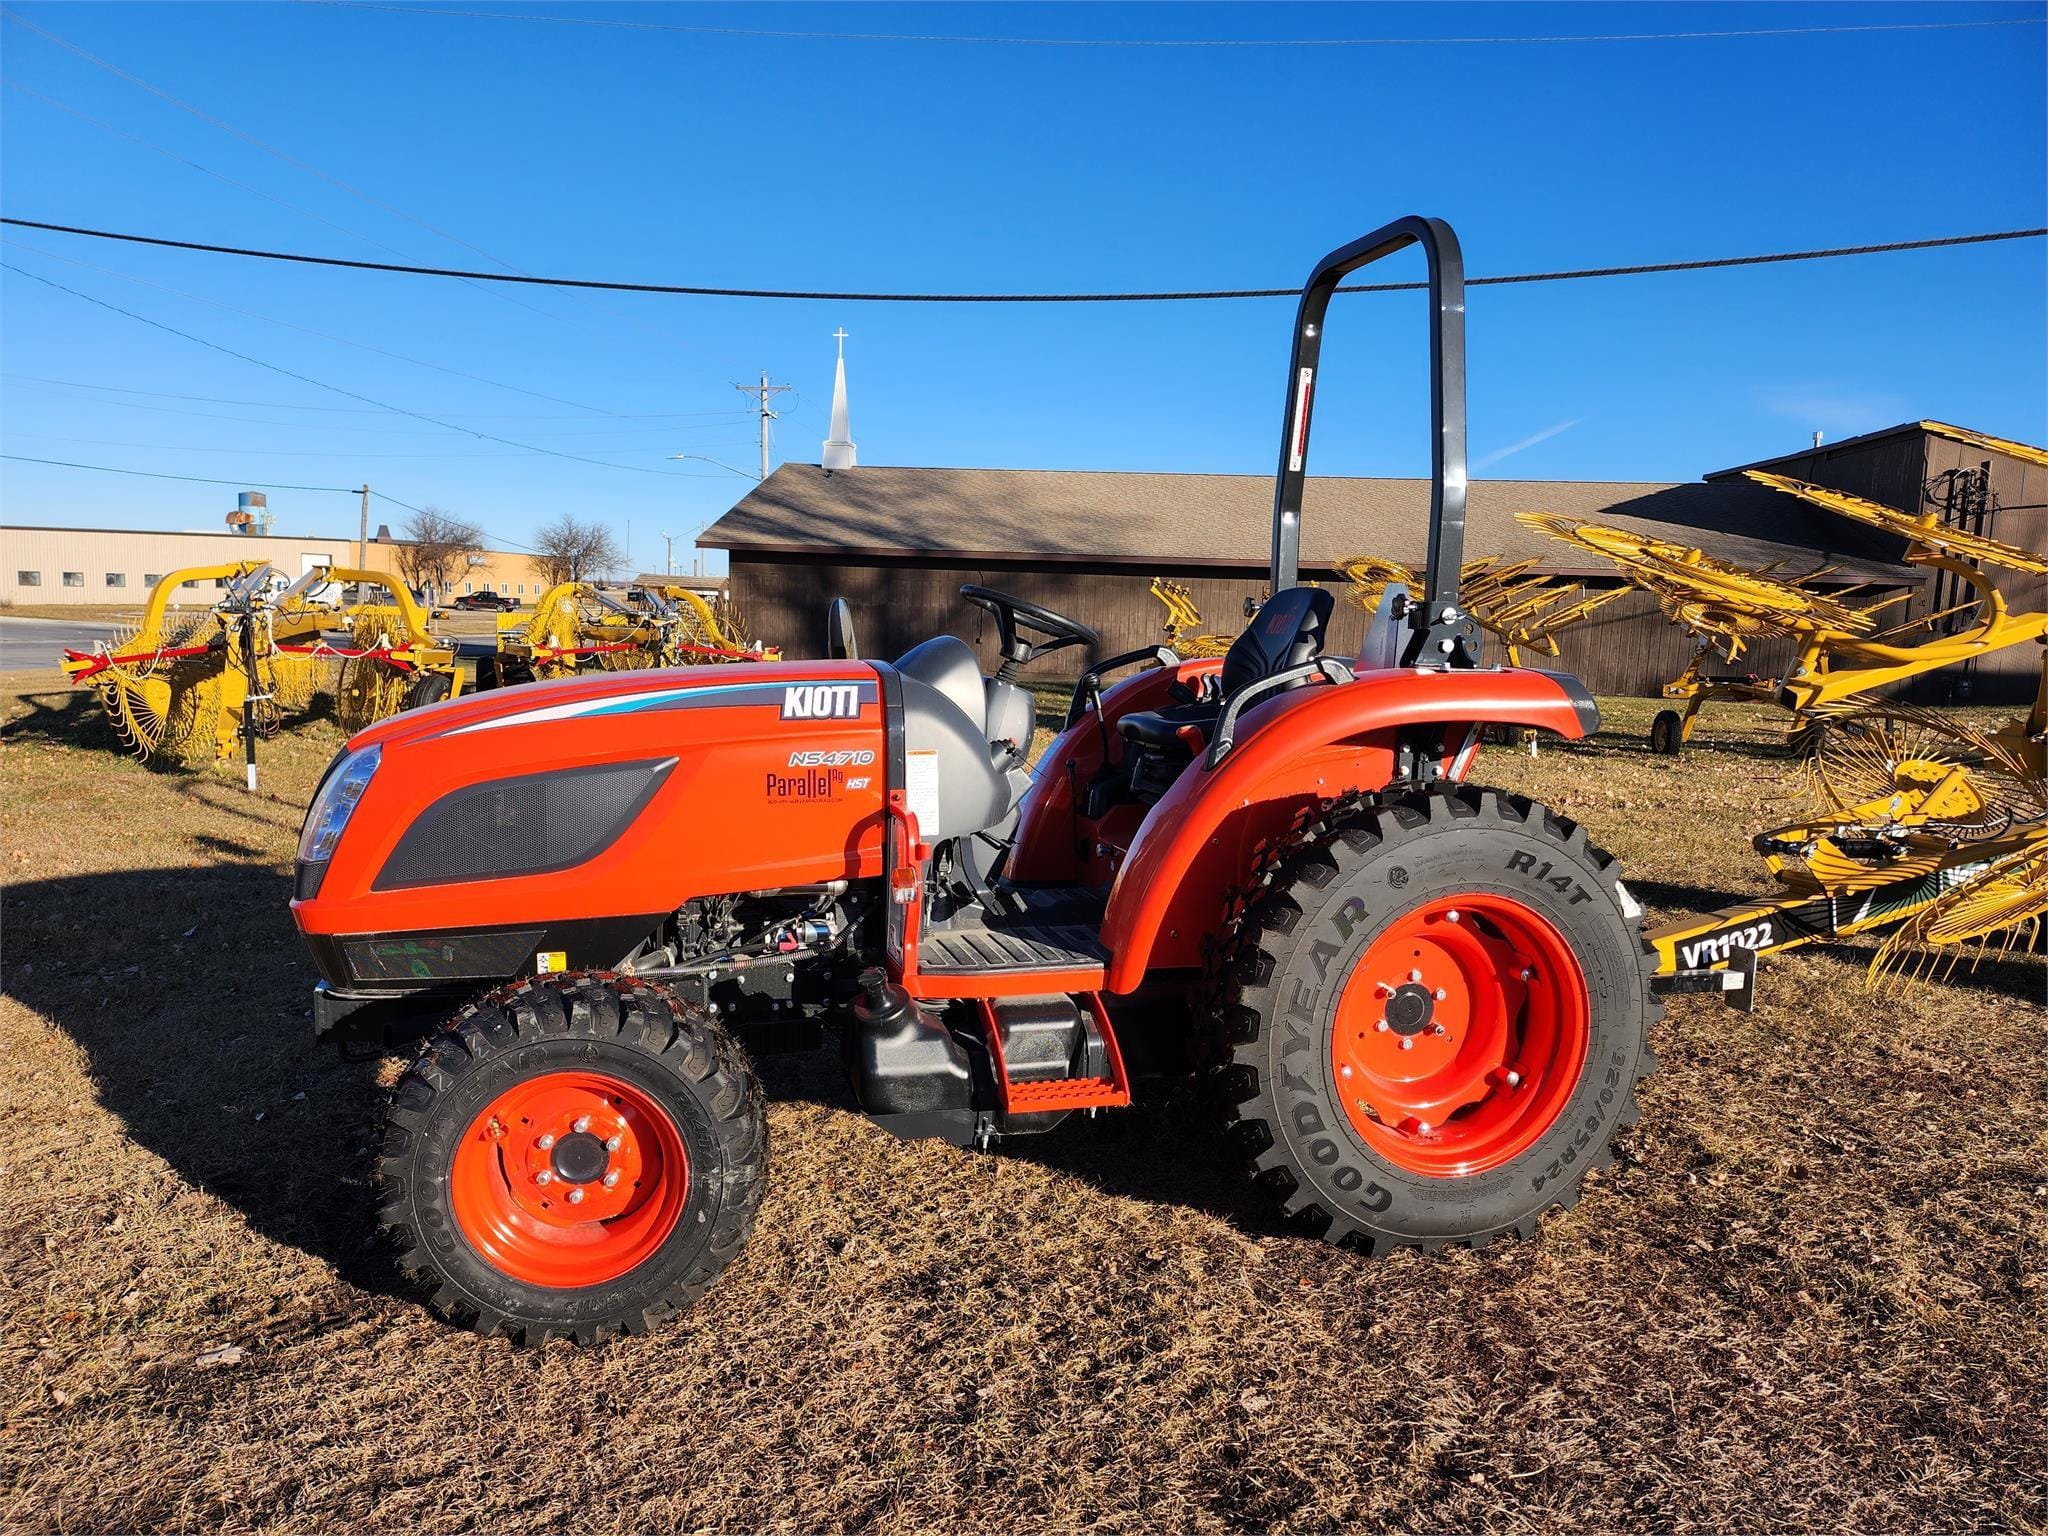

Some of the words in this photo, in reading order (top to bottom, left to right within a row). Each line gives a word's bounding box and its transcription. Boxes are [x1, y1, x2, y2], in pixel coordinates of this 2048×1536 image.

[783, 685, 859, 718] KIOTI
[788, 750, 875, 768] NS4710
[766, 769, 832, 798] Parallel
[845, 777, 872, 790] HST
[1506, 849, 1594, 906] R14T
[1681, 922, 1774, 969] VR1022
[1278, 895, 1393, 1213] GOODYEAR
[1531, 1050, 1627, 1194] 320/85R24
